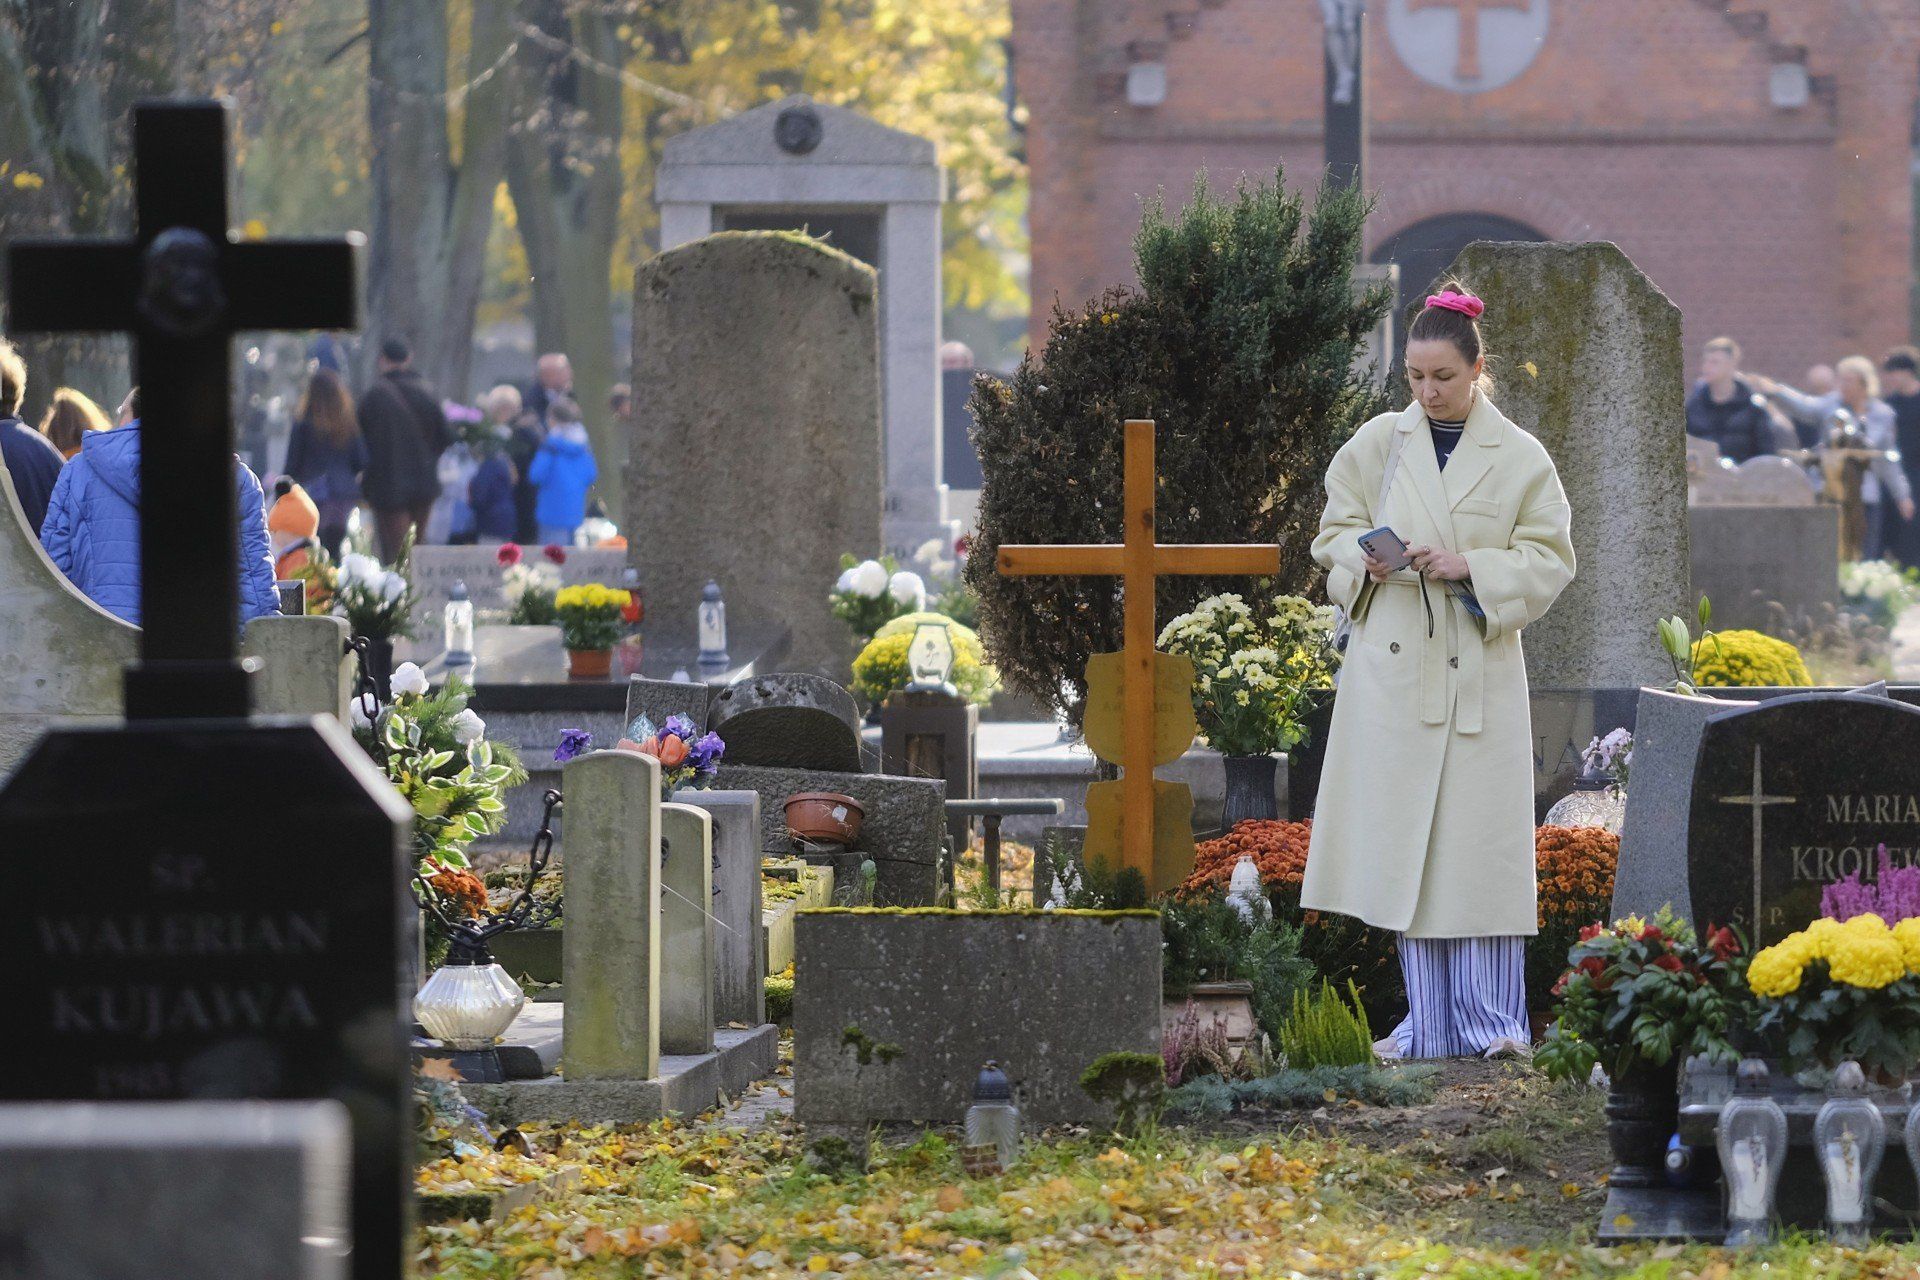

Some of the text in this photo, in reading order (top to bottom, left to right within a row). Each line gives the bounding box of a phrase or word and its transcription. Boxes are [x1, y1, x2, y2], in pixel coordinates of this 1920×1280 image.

[1826, 794, 1920, 823] MARIA
[36, 911, 330, 956] WALERIAN
[51, 982, 319, 1041] KUJAWA
